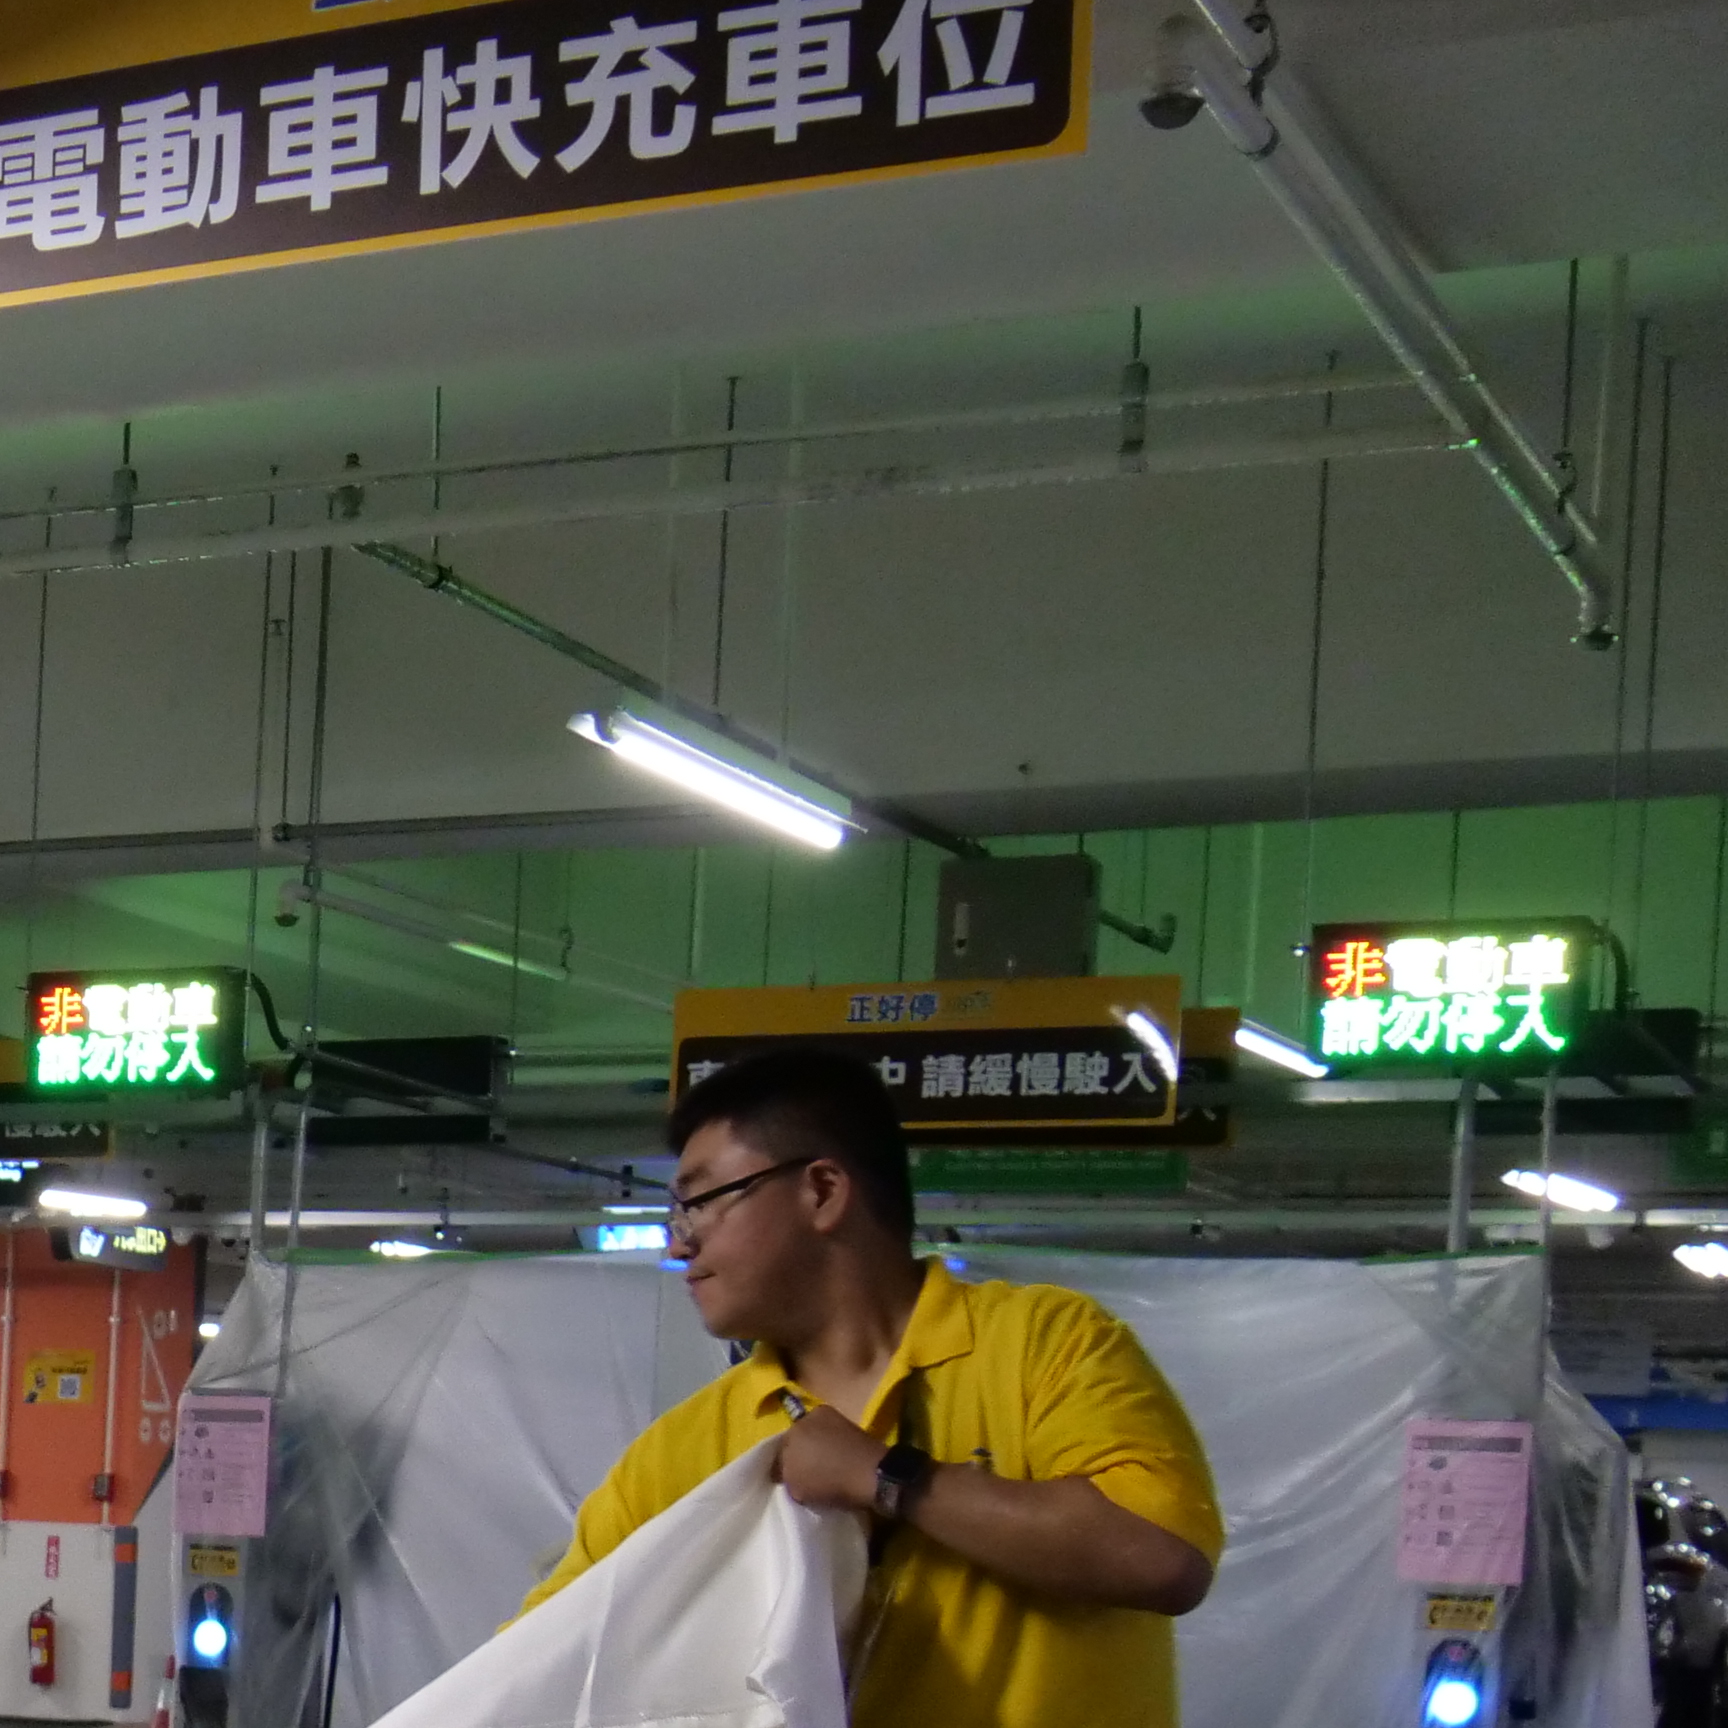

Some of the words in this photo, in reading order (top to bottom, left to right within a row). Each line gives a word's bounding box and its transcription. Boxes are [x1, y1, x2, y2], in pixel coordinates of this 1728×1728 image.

[1325, 935, 1570, 998] 非電動車
[846, 993, 938, 1022] 正好停
[1321, 994, 1566, 1055] 請勿停入
[37, 1032, 215, 1084] 請勿停入
[921, 1051, 1157, 1098] 請緩慢駛入
